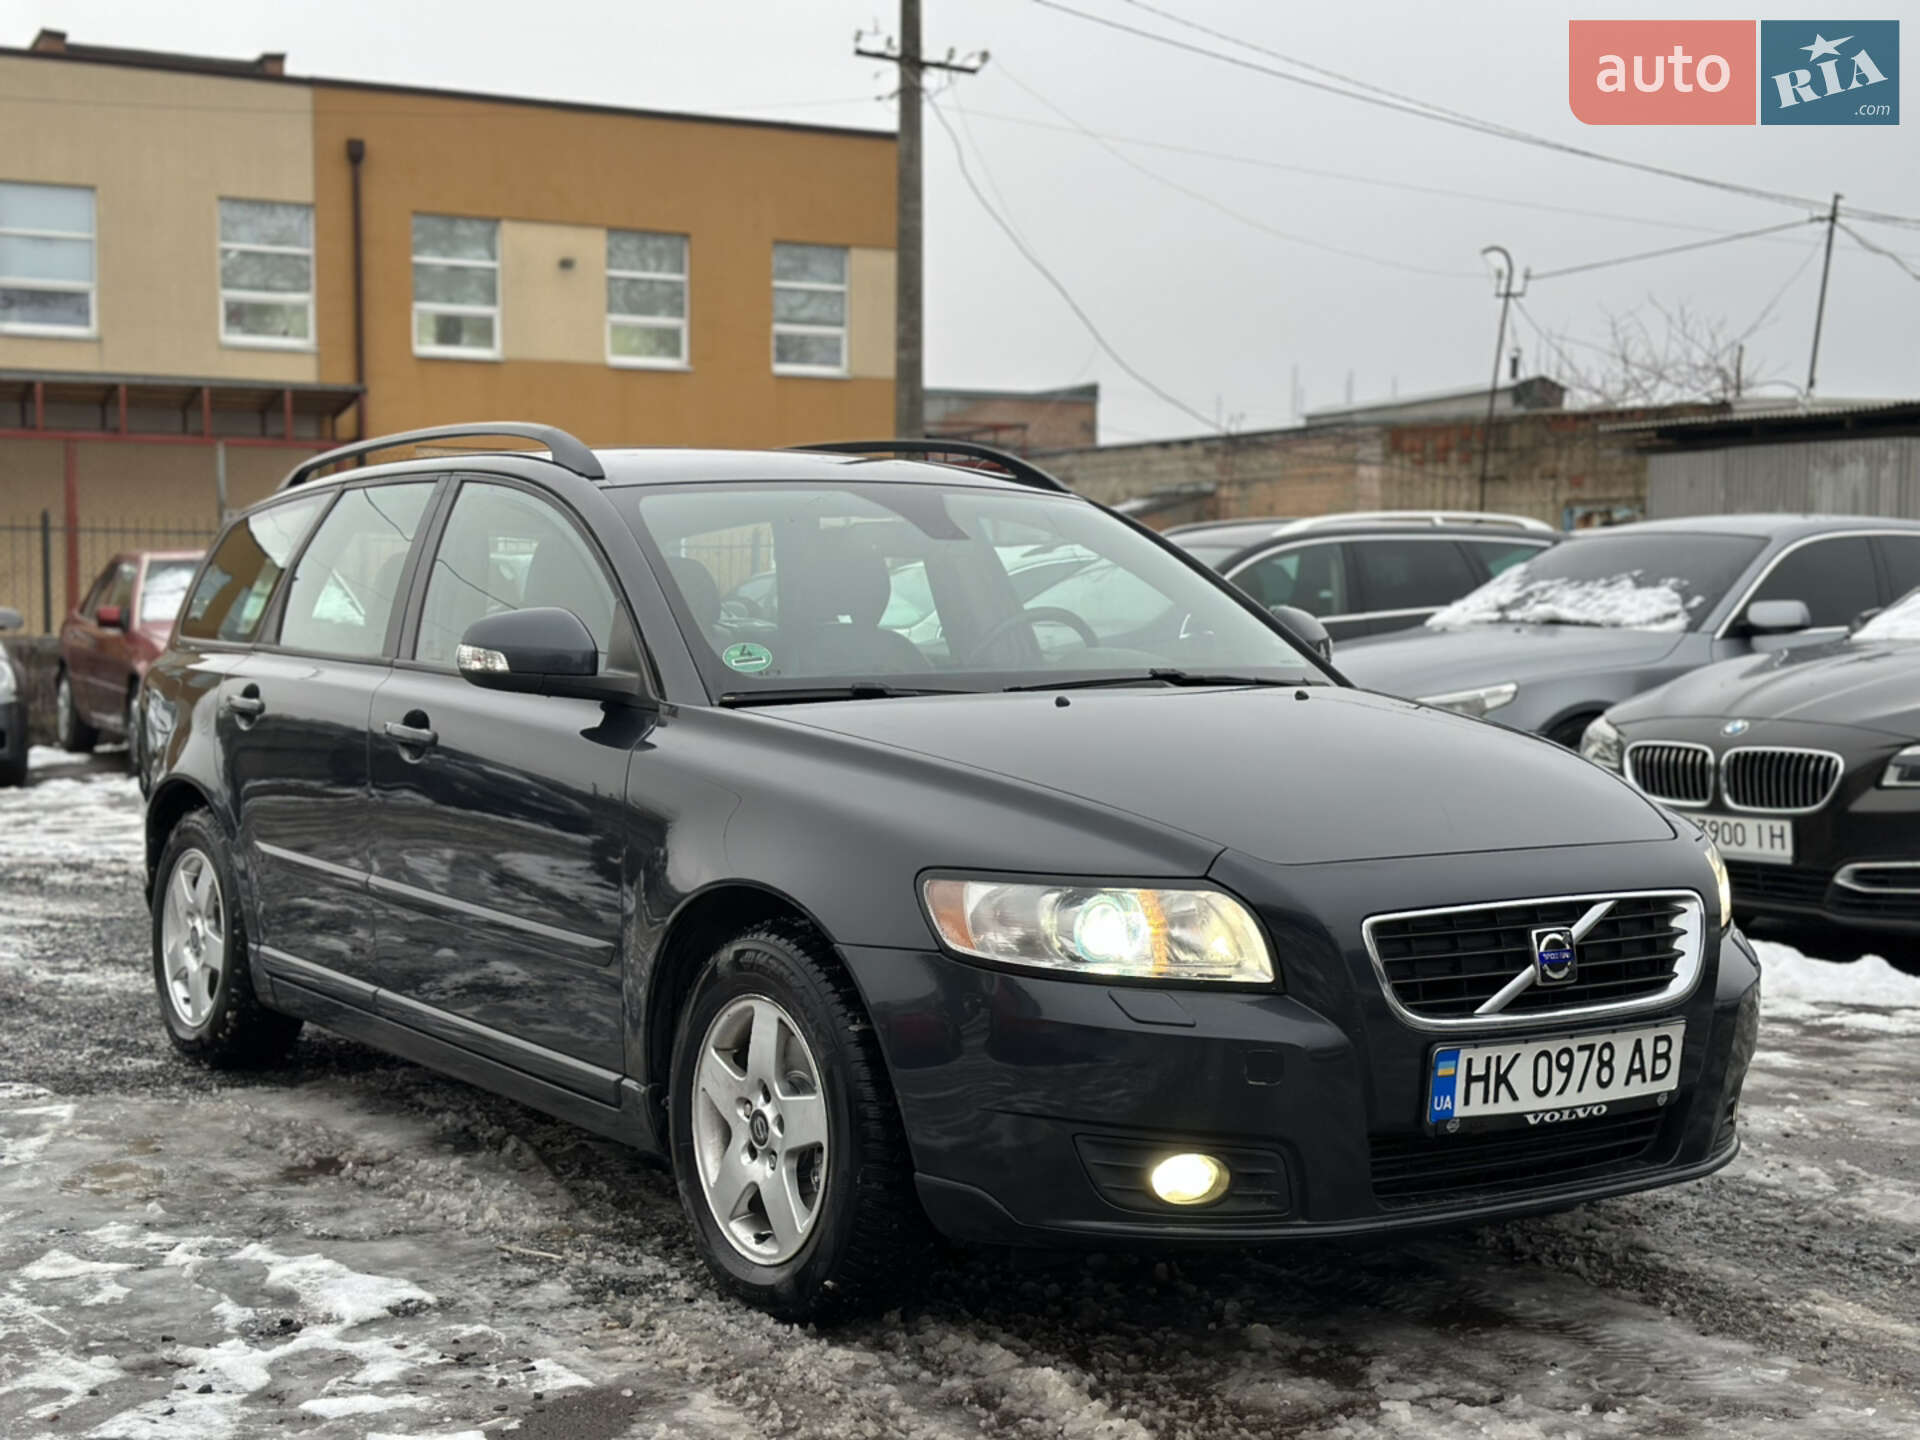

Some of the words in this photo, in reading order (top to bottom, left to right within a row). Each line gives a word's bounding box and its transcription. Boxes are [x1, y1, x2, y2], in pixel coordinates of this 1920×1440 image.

[1463, 1052, 1521, 1106] HK
[1532, 1041, 1616, 1098] 0978
[1624, 1034, 1674, 1087] AB
[1434, 1096, 1453, 1111] UA
[1524, 1104, 1608, 1126] VOLVO
